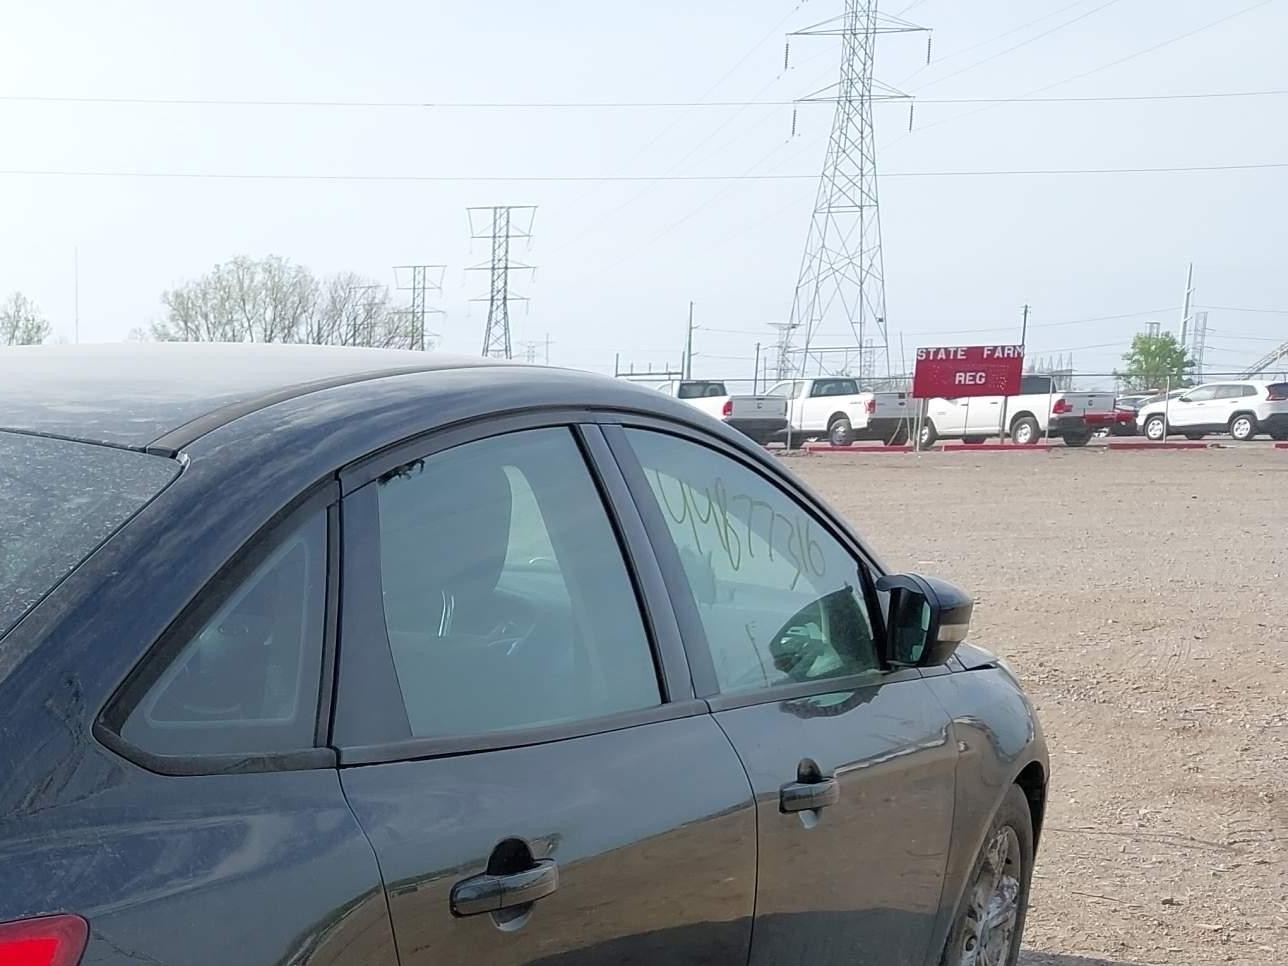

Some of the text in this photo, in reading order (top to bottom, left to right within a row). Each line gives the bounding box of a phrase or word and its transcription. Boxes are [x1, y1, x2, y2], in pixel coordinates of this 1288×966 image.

[917, 345, 1025, 360] STATE FARM
[955, 372, 987, 385] REG
